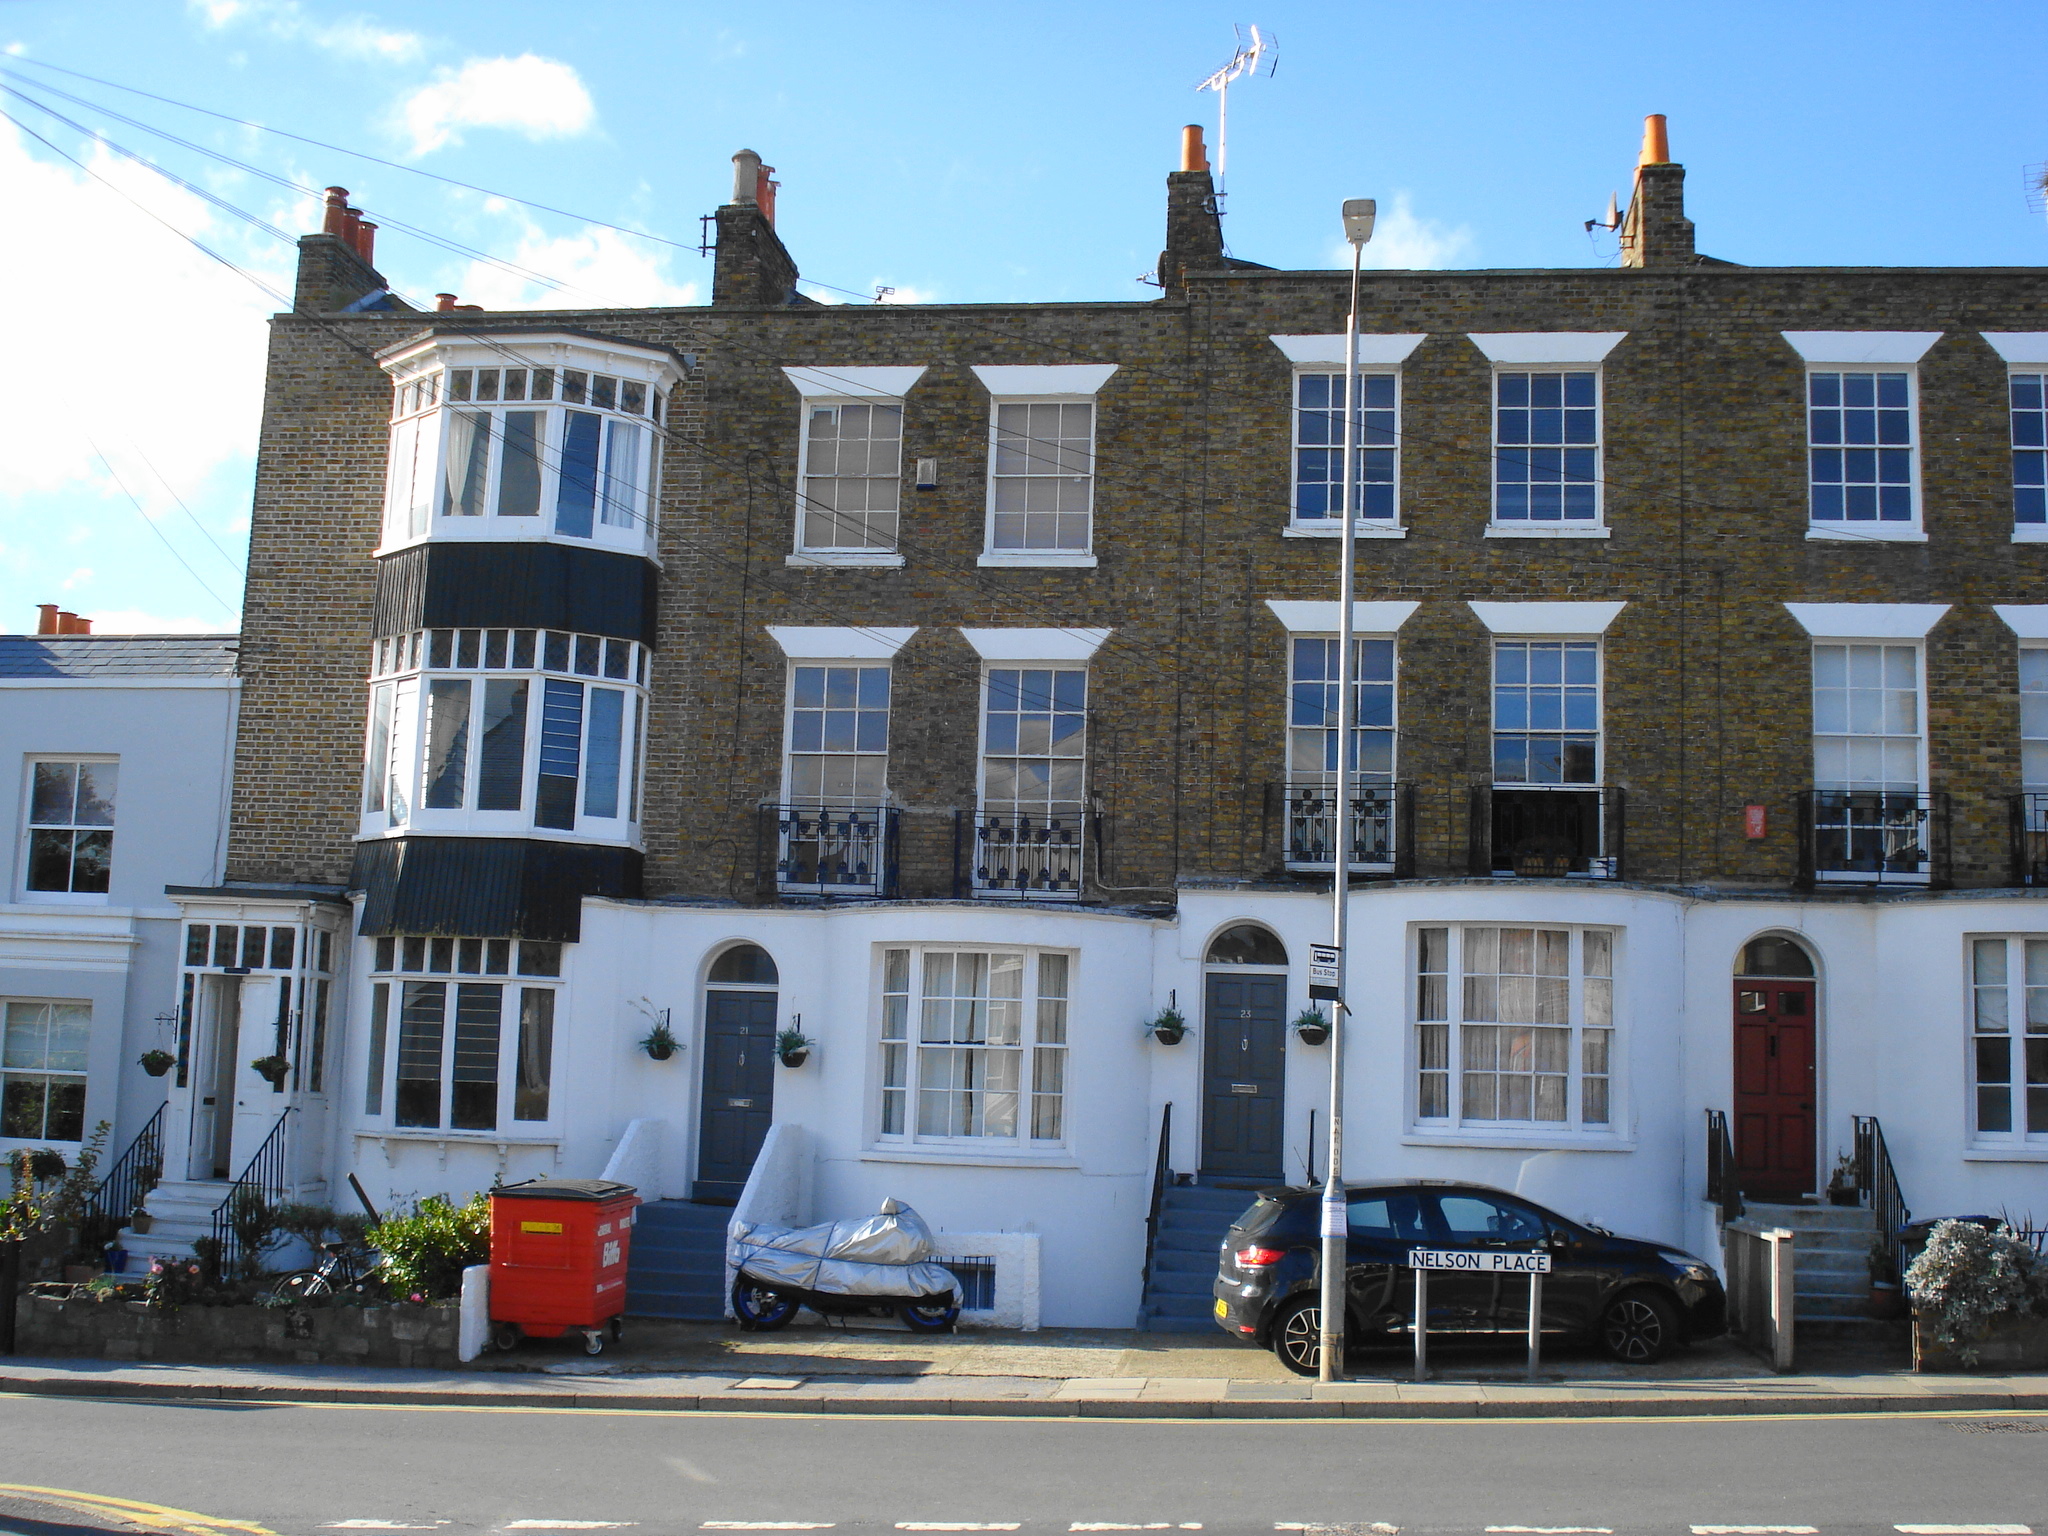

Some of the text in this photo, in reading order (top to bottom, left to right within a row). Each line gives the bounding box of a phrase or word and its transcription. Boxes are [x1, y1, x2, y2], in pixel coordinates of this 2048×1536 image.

[1324, 969, 1335, 977] Stop
[1240, 1009, 1251, 1018] 23
[739, 1026, 749, 1035] 21
[1412, 1252, 1547, 1272] NELSON PLACE
